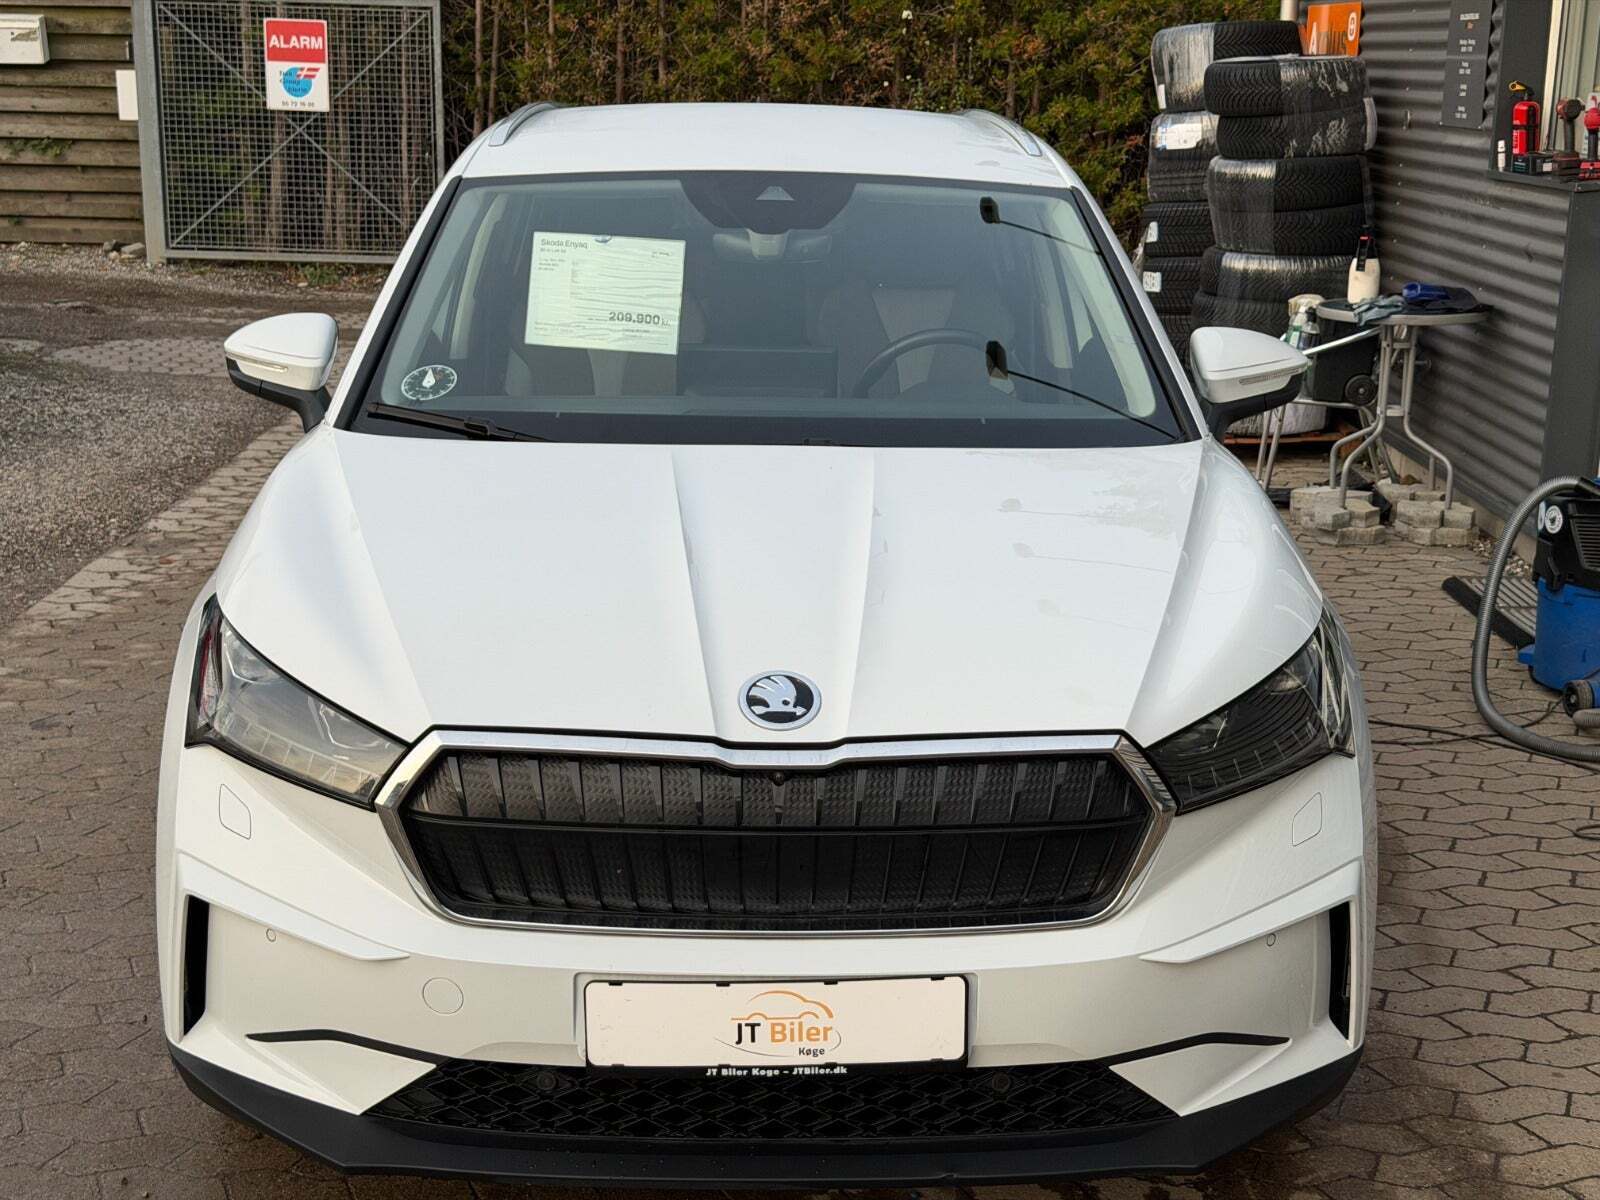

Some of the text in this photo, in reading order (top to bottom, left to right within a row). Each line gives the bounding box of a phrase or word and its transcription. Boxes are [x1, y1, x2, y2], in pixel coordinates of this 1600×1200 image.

[269, 35, 323, 50] ALARM
[735, 1022, 832, 1045] JT Biler
[798, 1047, 825, 1057] Køge
[706, 1068, 718, 1076] JT
[721, 1068, 748, 1076] Biler
[792, 1066, 848, 1075] JTBiler.dk
